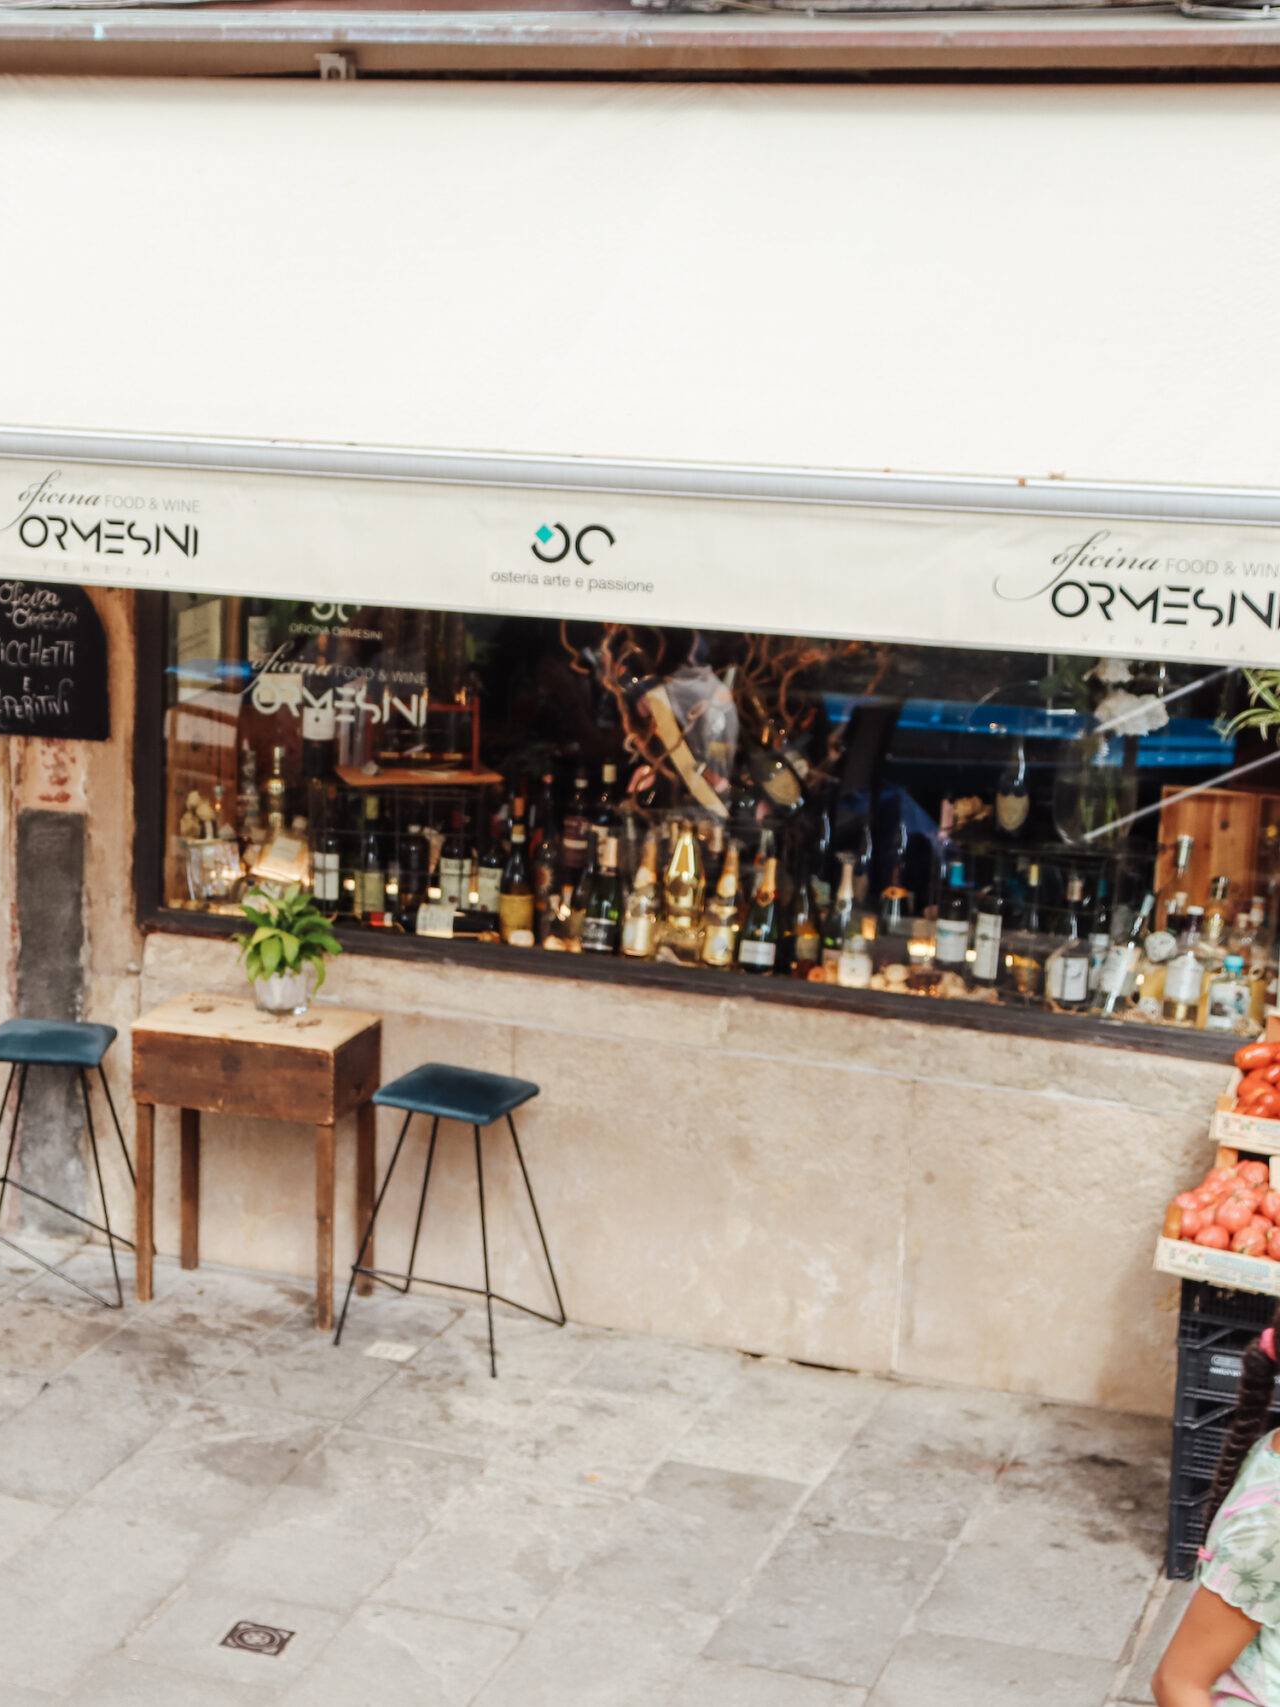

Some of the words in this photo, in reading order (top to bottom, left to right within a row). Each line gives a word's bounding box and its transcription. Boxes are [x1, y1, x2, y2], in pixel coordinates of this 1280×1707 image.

[104, 494, 145, 510] FOOD
[148, 497, 158, 510] &
[163, 498, 200, 513] WINE
[20, 514, 197, 558] ORMESINI
[1165, 557, 1219, 575] FOOD
[1223, 560, 1237, 576] &
[1242, 562, 1280, 578] WIN
[490, 569, 539, 585] osteria
[543, 574, 570, 587] arte
[575, 577, 584, 588] e
[588, 576, 655, 593] passione
[333, 664, 375, 680] FOOD
[391, 670, 427, 685] WINE
[251, 682, 428, 728] ORMESINI
